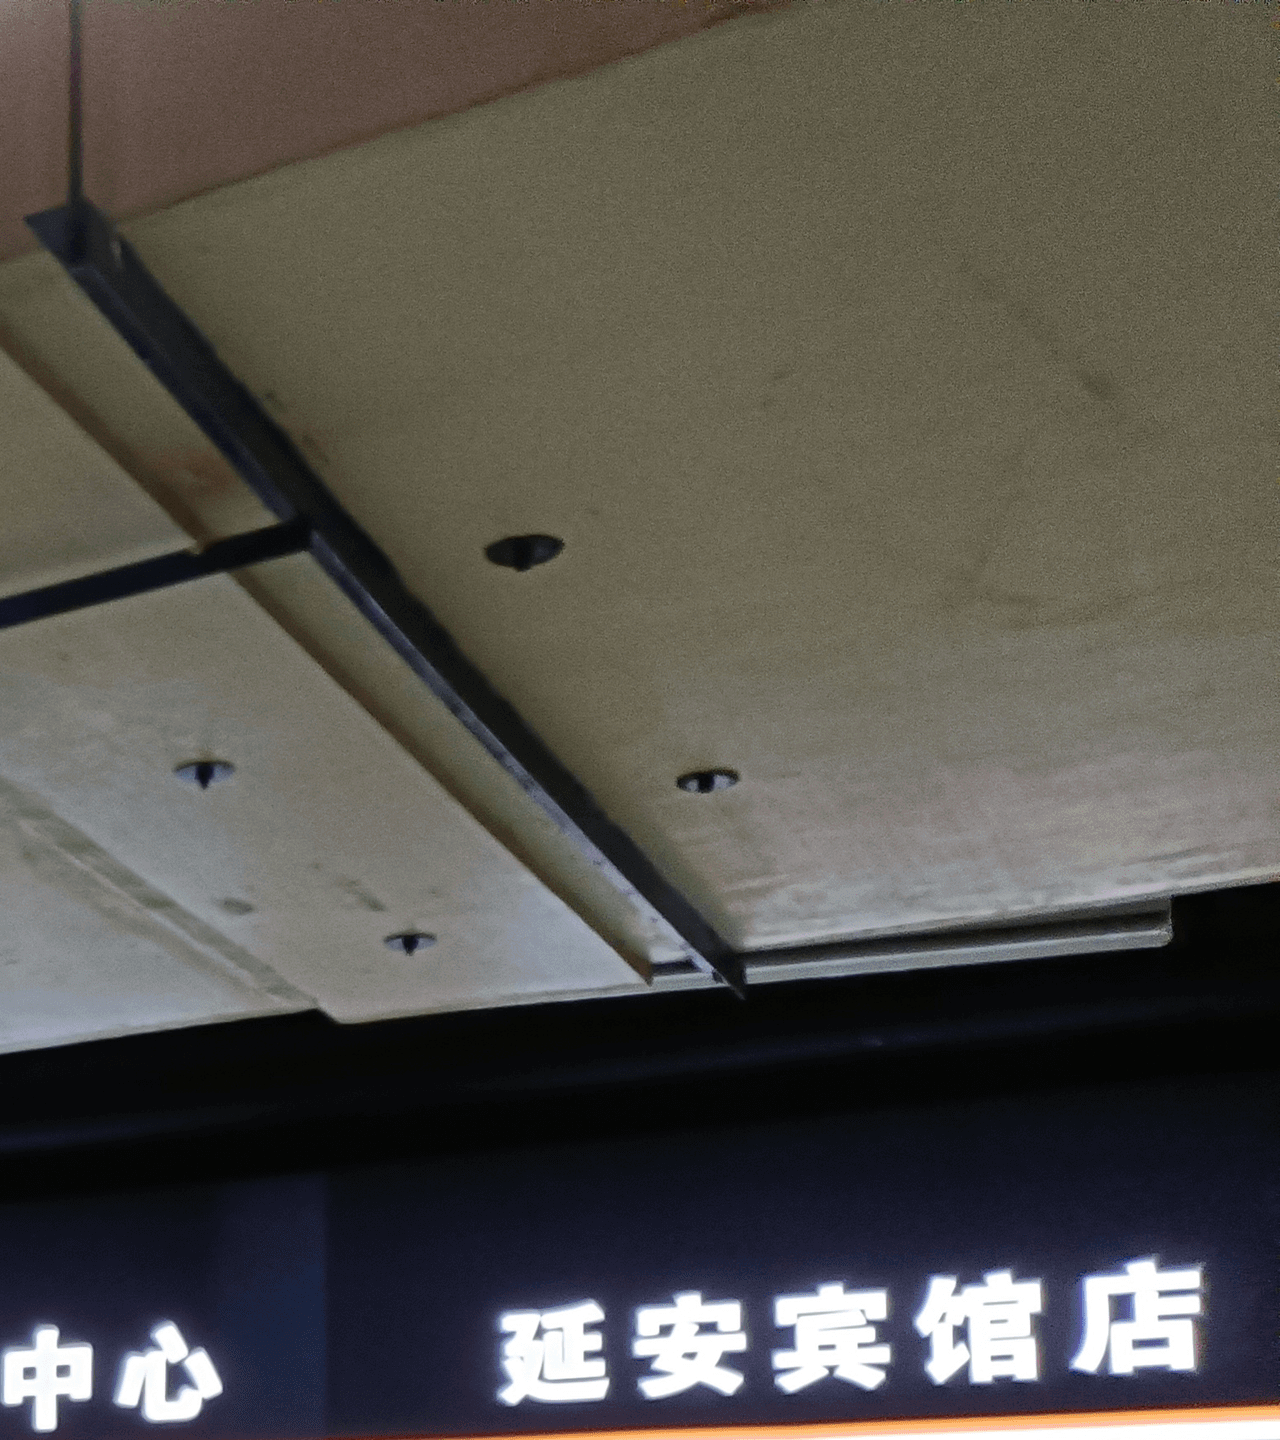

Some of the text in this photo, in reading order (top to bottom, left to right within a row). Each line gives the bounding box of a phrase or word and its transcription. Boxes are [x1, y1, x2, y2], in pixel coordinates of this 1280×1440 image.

[499, 1257, 1206, 1405] 延安宾馆店
